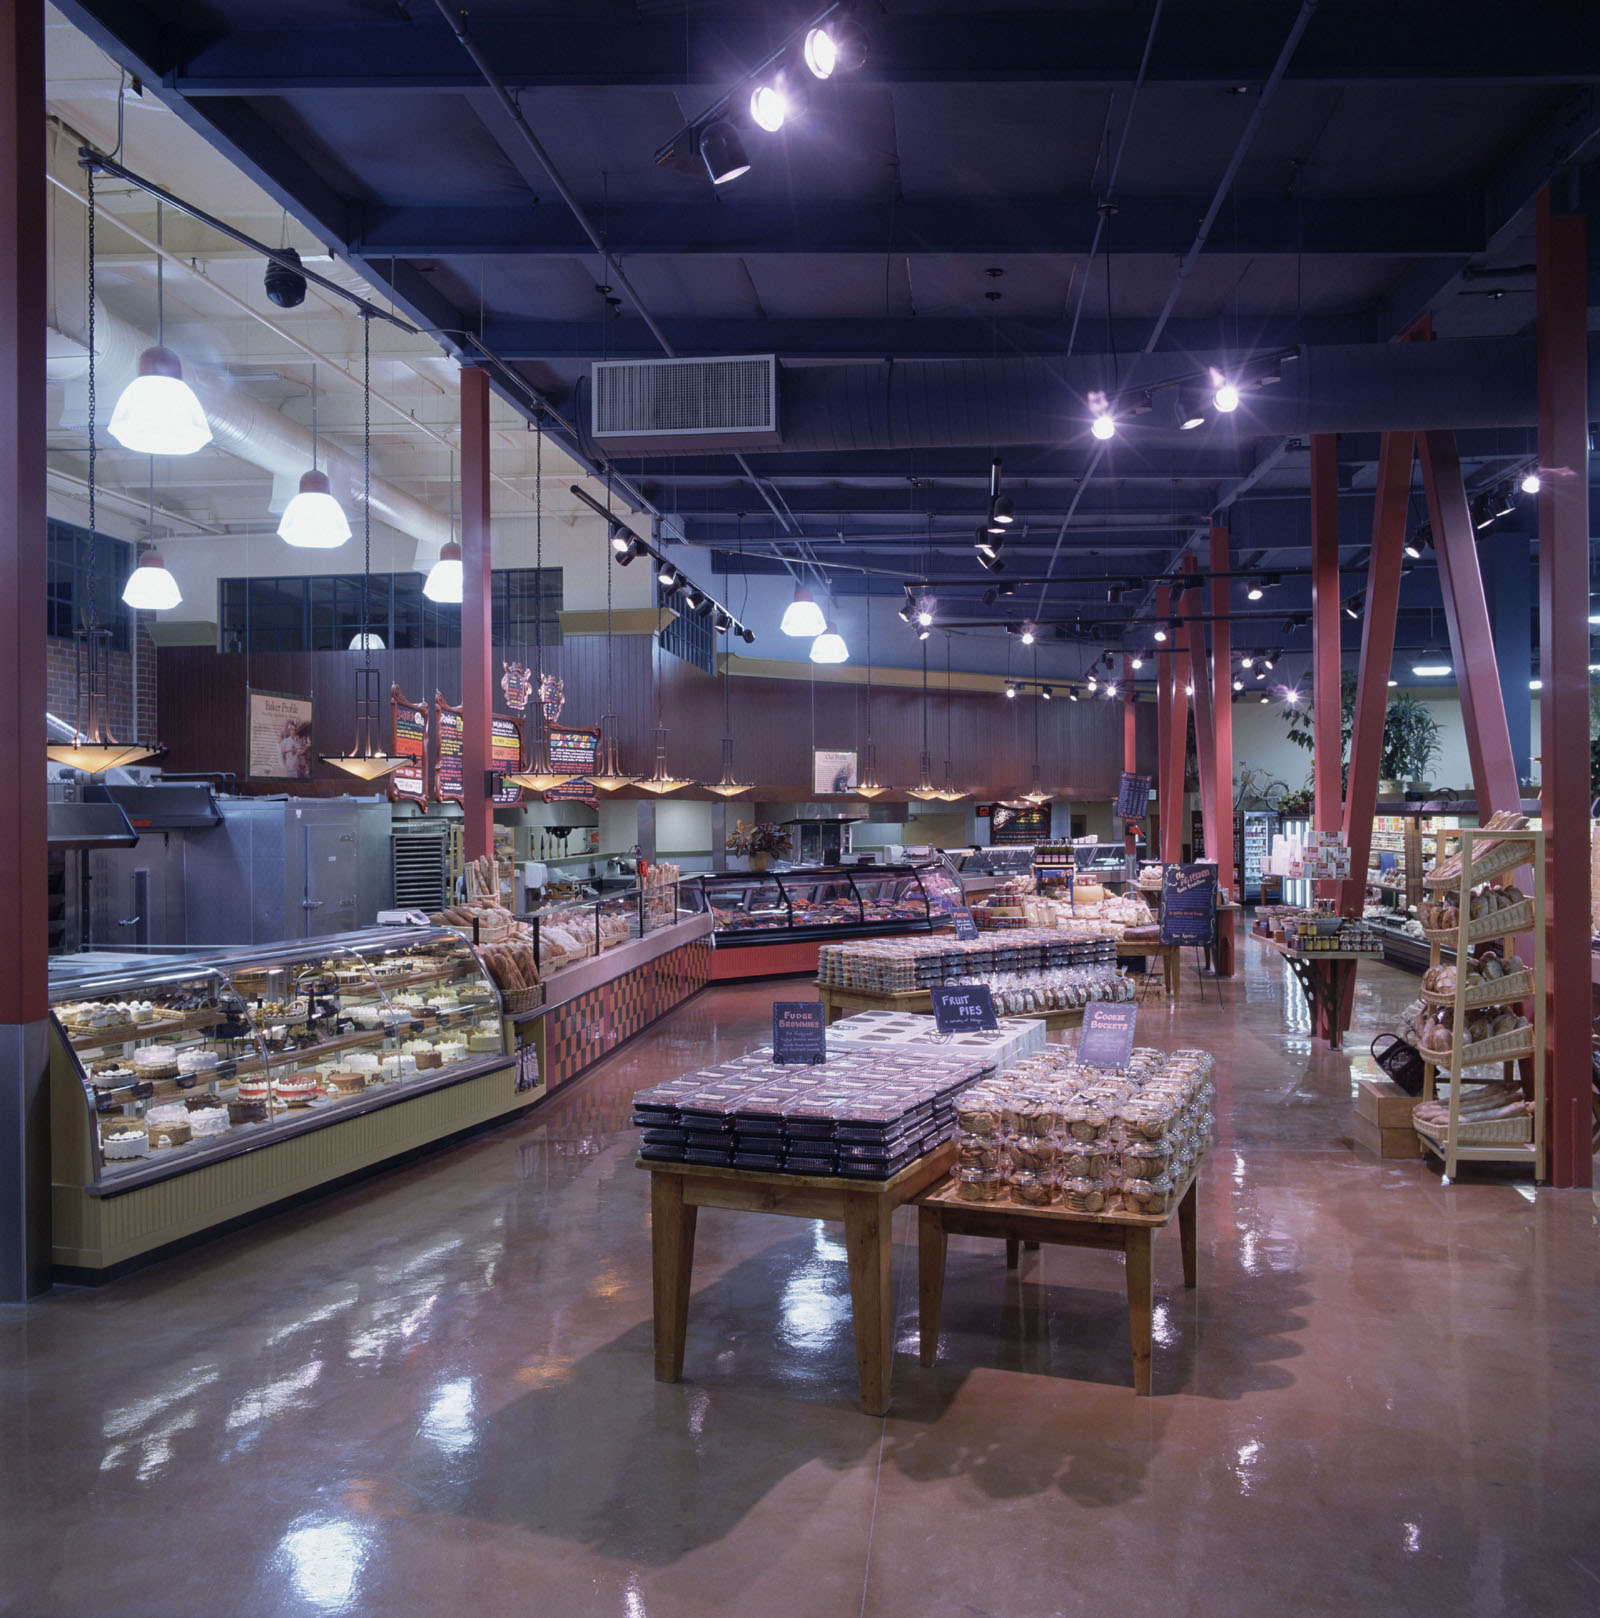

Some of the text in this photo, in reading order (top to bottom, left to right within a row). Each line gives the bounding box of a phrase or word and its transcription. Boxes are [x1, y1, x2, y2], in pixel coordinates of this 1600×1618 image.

[265, 700, 281, 712] Baker
[941, 994, 969, 1006] FRUIT
[784, 1011, 813, 1019] FUDGE
[959, 1005, 983, 1016] PIES
[1094, 1010, 1127, 1021] COOKIE
[779, 1019, 820, 1028] BROWNIES
[1090, 1020, 1128, 1031] BUCKETS
